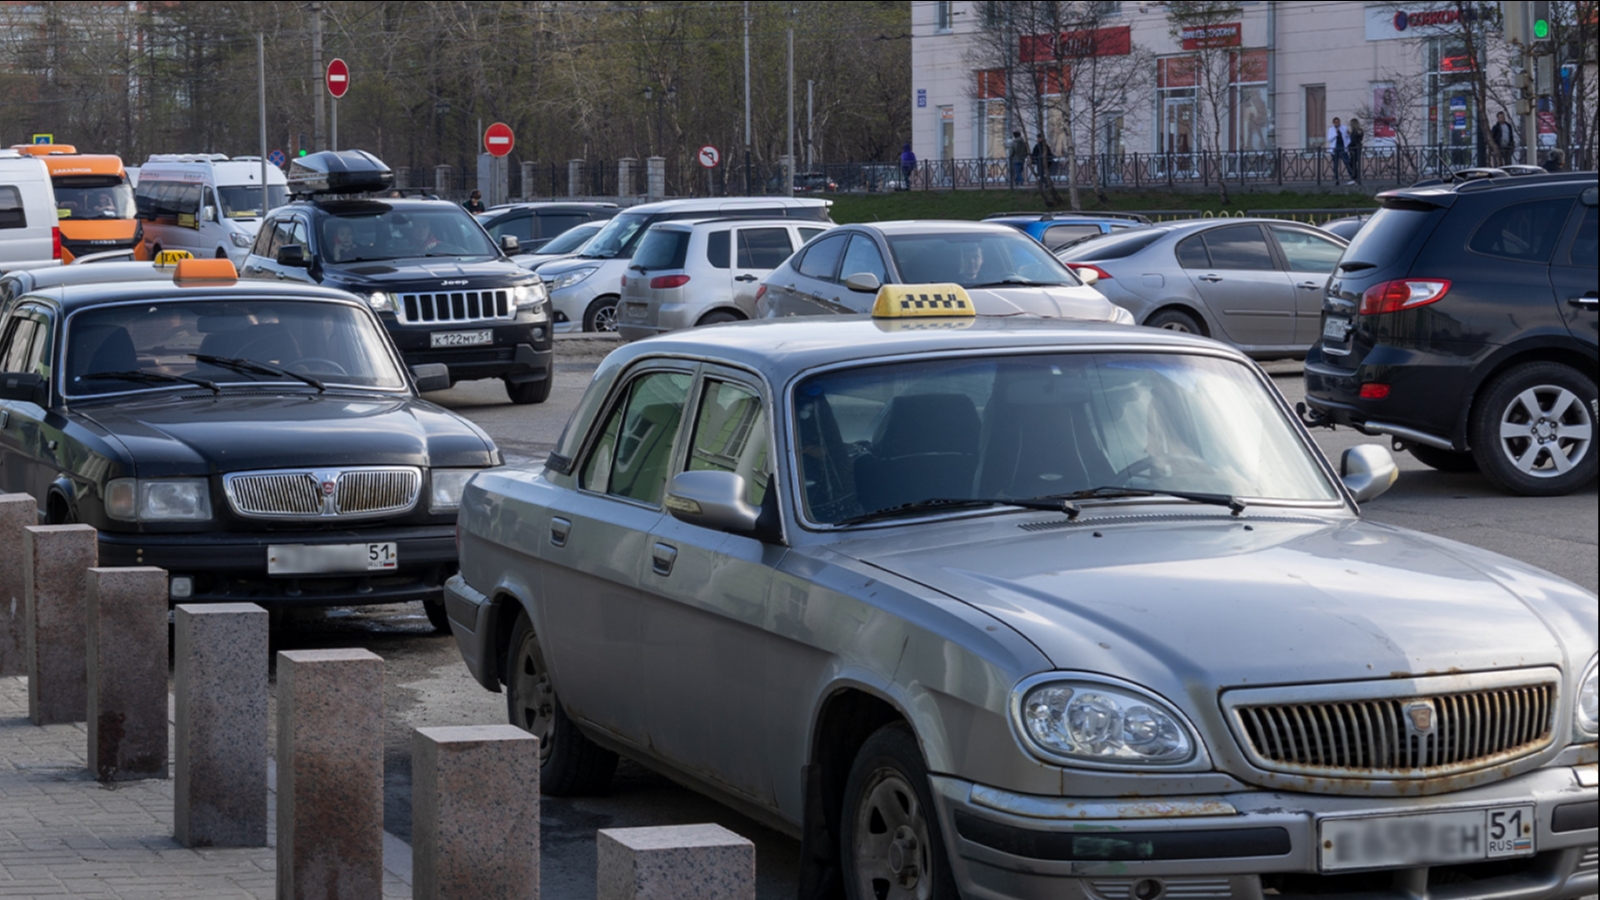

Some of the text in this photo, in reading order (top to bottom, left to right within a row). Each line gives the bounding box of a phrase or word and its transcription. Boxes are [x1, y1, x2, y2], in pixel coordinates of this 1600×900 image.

[478, 331, 489, 341] 51
[369, 544, 390, 561] 51
[1490, 809, 1523, 840] 51
[1489, 839, 1513, 852] RUS
